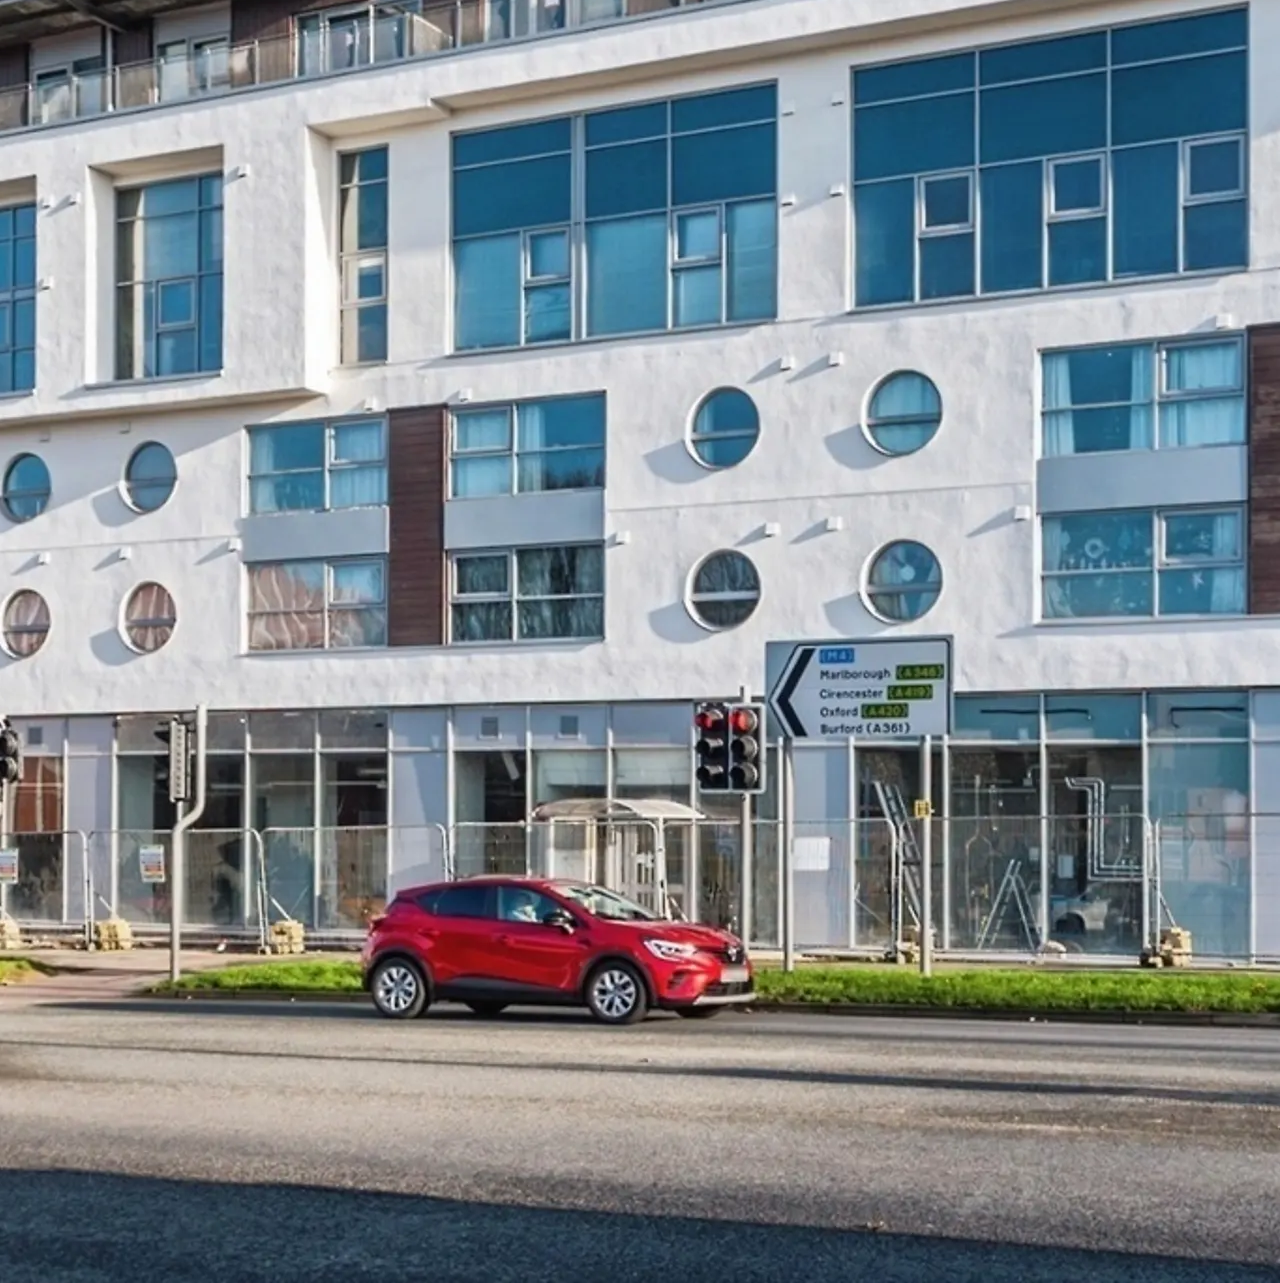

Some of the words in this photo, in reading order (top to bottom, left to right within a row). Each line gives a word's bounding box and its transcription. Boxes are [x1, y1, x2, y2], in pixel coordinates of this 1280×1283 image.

[820, 668, 891, 680] Marlborough
[820, 688, 883, 700] Cirencester
[888, 686, 932, 699] (A419)
[820, 706, 858, 718] Oxford
[863, 704, 908, 718] (A420)
[820, 723, 863, 735] Burford
[866, 722, 911, 734] (A361)
